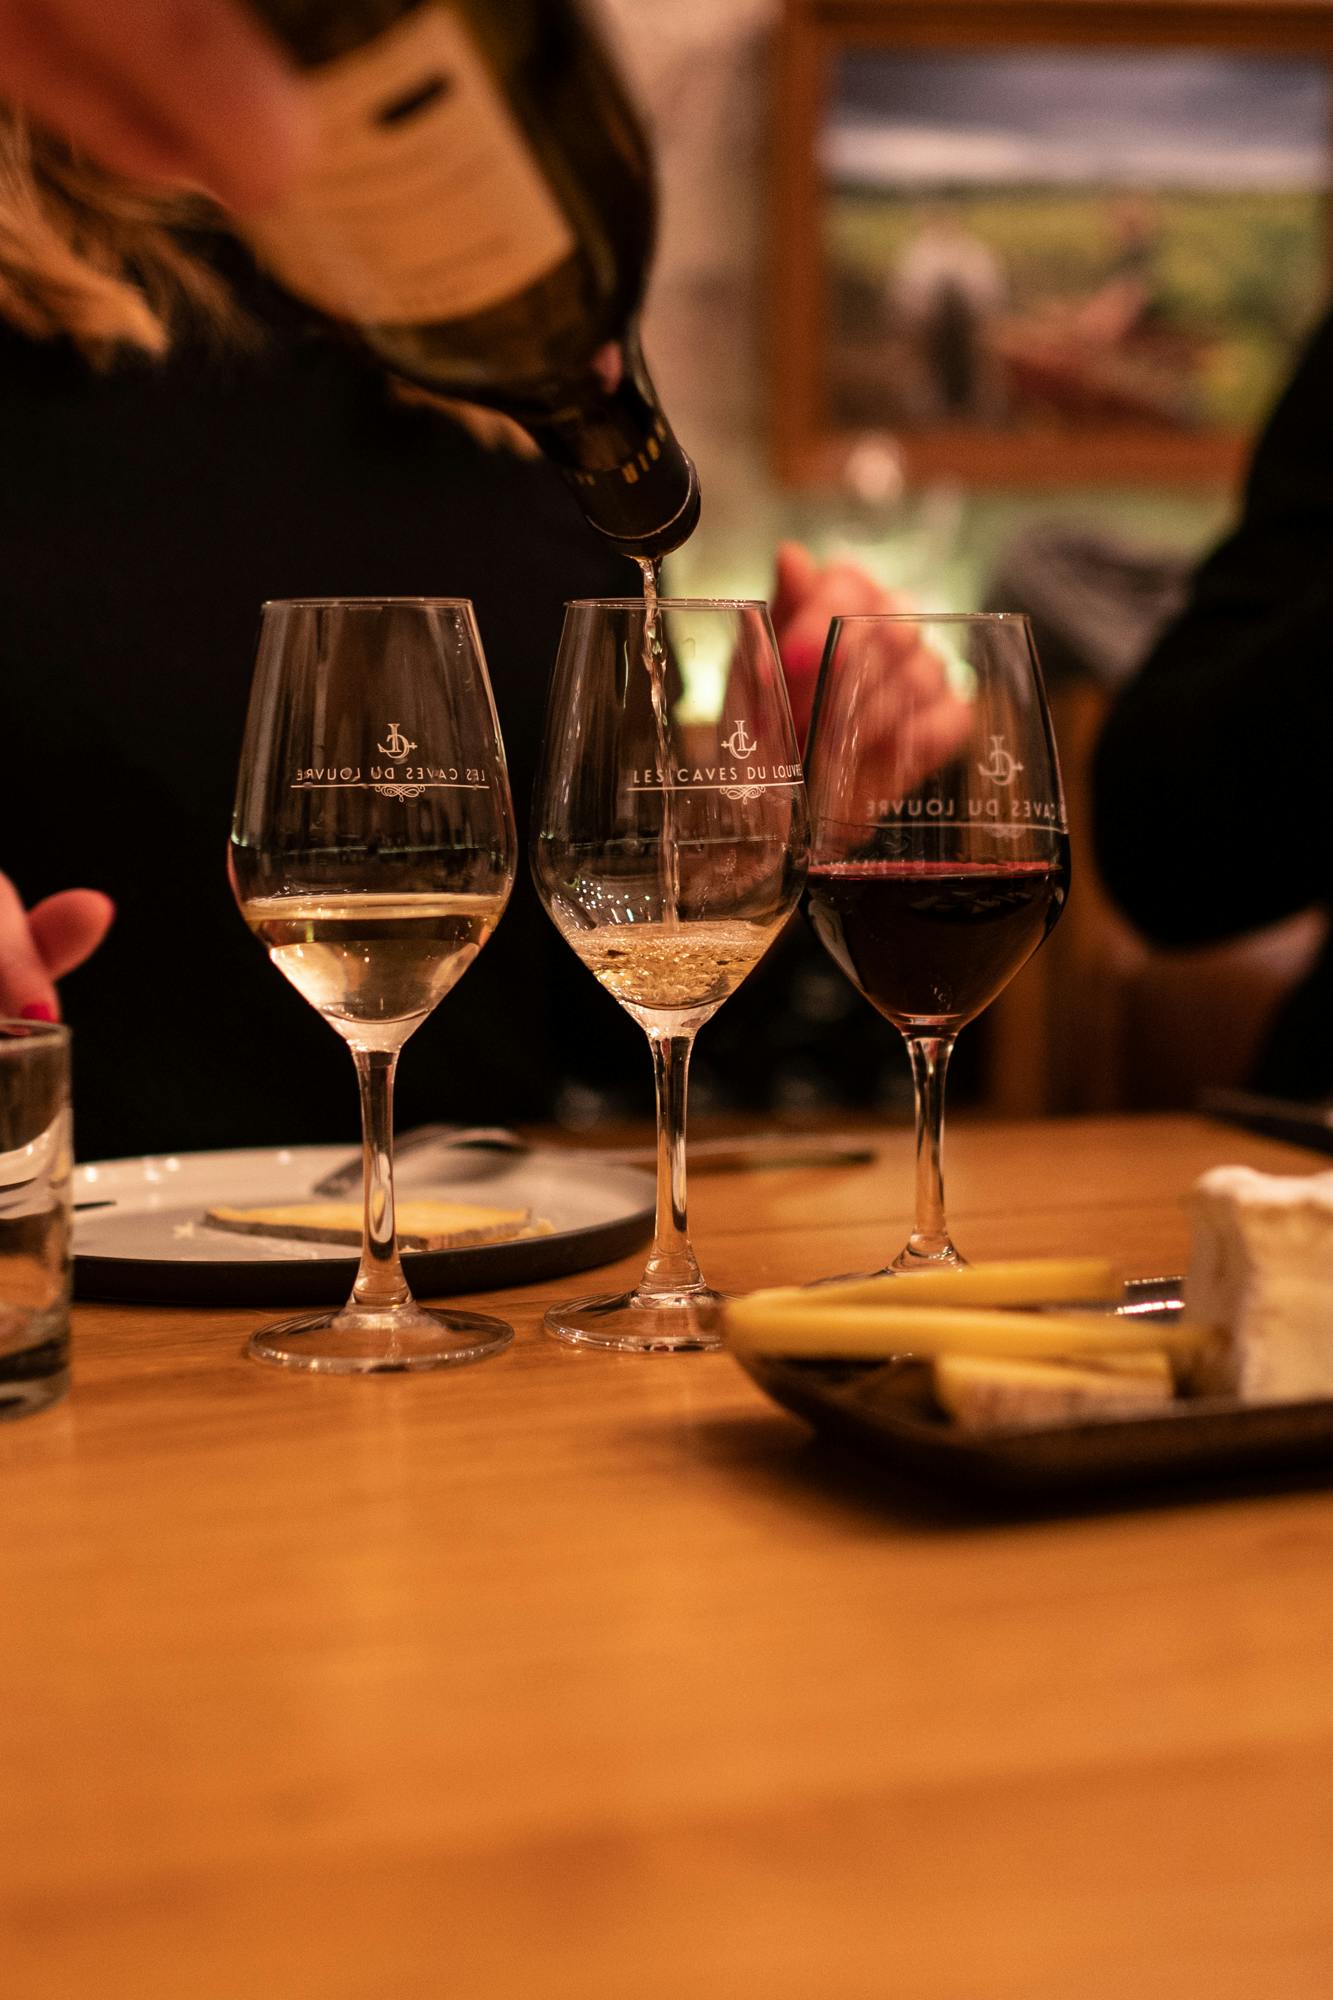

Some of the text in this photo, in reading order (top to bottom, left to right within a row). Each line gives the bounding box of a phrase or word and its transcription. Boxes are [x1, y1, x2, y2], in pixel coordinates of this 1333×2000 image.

[633, 768, 665, 784] LES
[676, 766, 738, 783] CAVES
[747, 765, 767, 780] DU
